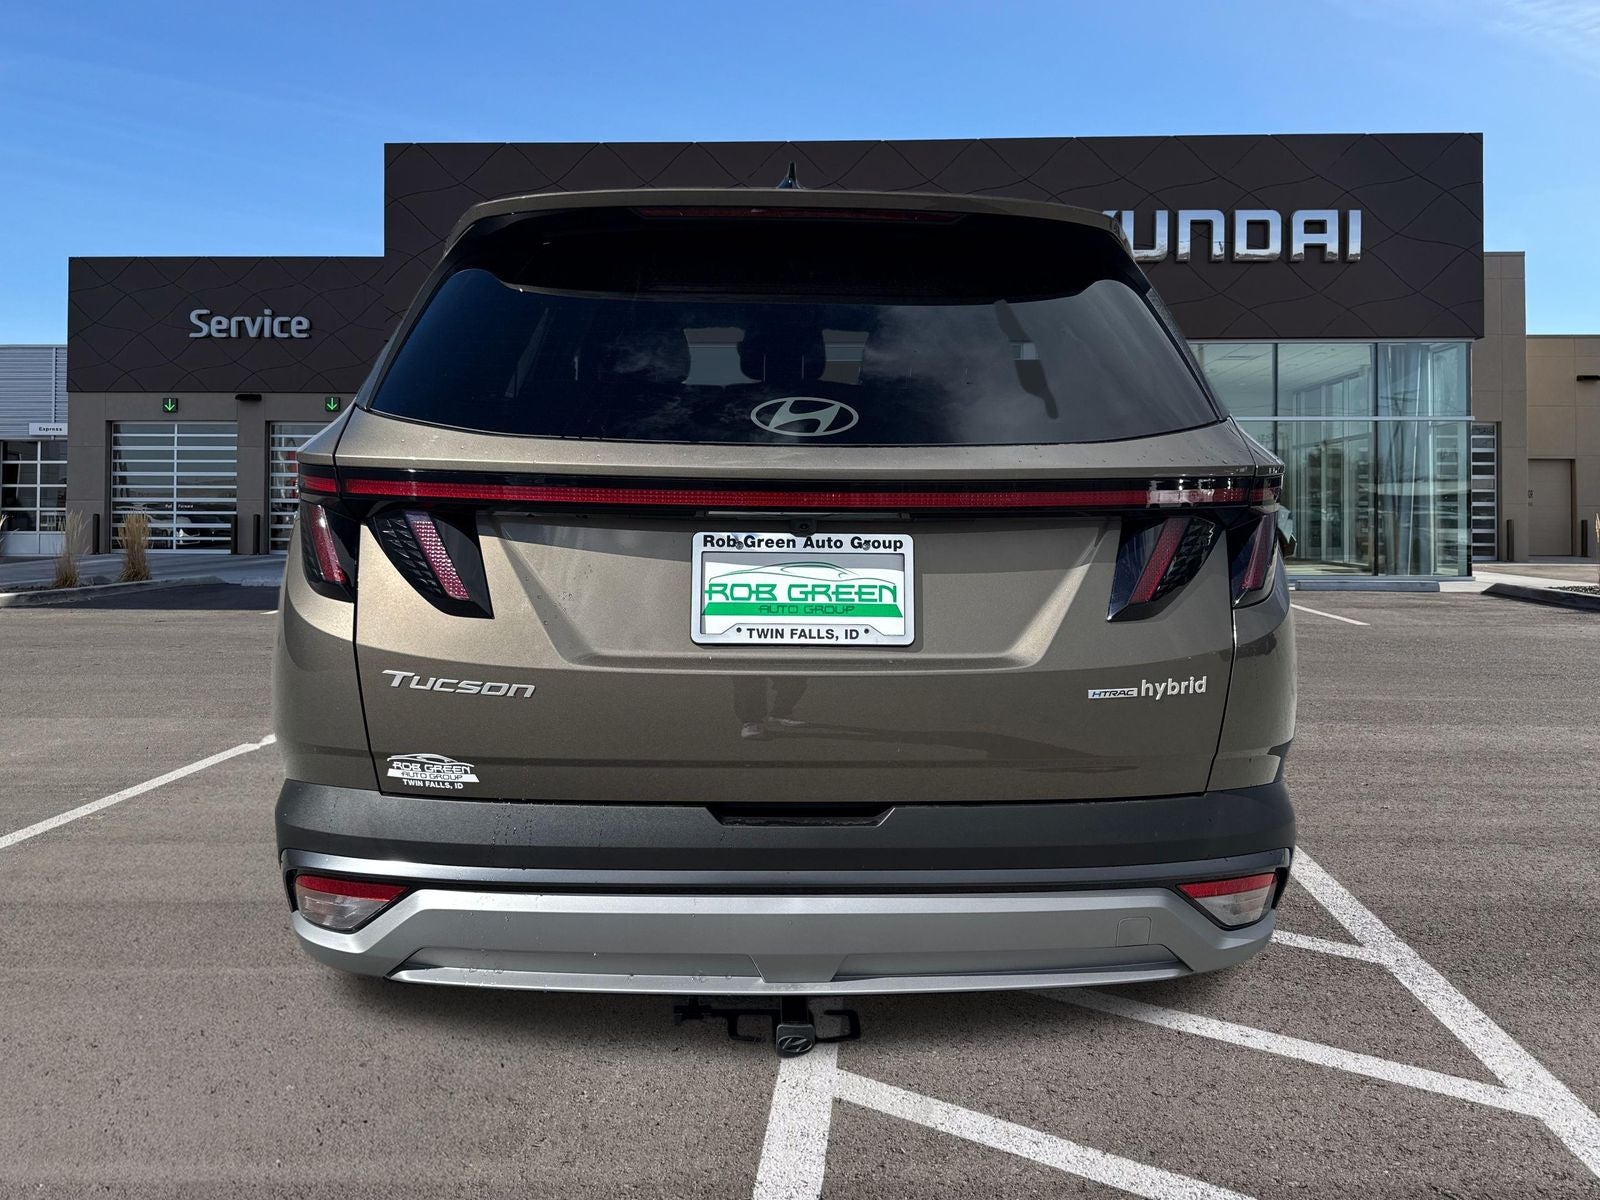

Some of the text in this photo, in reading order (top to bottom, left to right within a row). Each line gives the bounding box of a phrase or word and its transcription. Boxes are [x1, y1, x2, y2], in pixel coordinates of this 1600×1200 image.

[1102, 209, 1362, 263] UNDAI
[189, 308, 311, 338] Service
[703, 535, 904, 552] Rob Green Auto Group
[704, 583, 898, 603] ROB GREEN
[758, 604, 855, 615] AUTO GROUP
[746, 628, 860, 641] TWIN FALLS, ID
[1091, 675, 1208, 700] HTRAC hybrid
[392, 761, 471, 774] ROB GREEN
[401, 771, 427, 779] AUTO
[402, 779, 423, 787] TWIN
[425, 780, 453, 789] FALLS,
